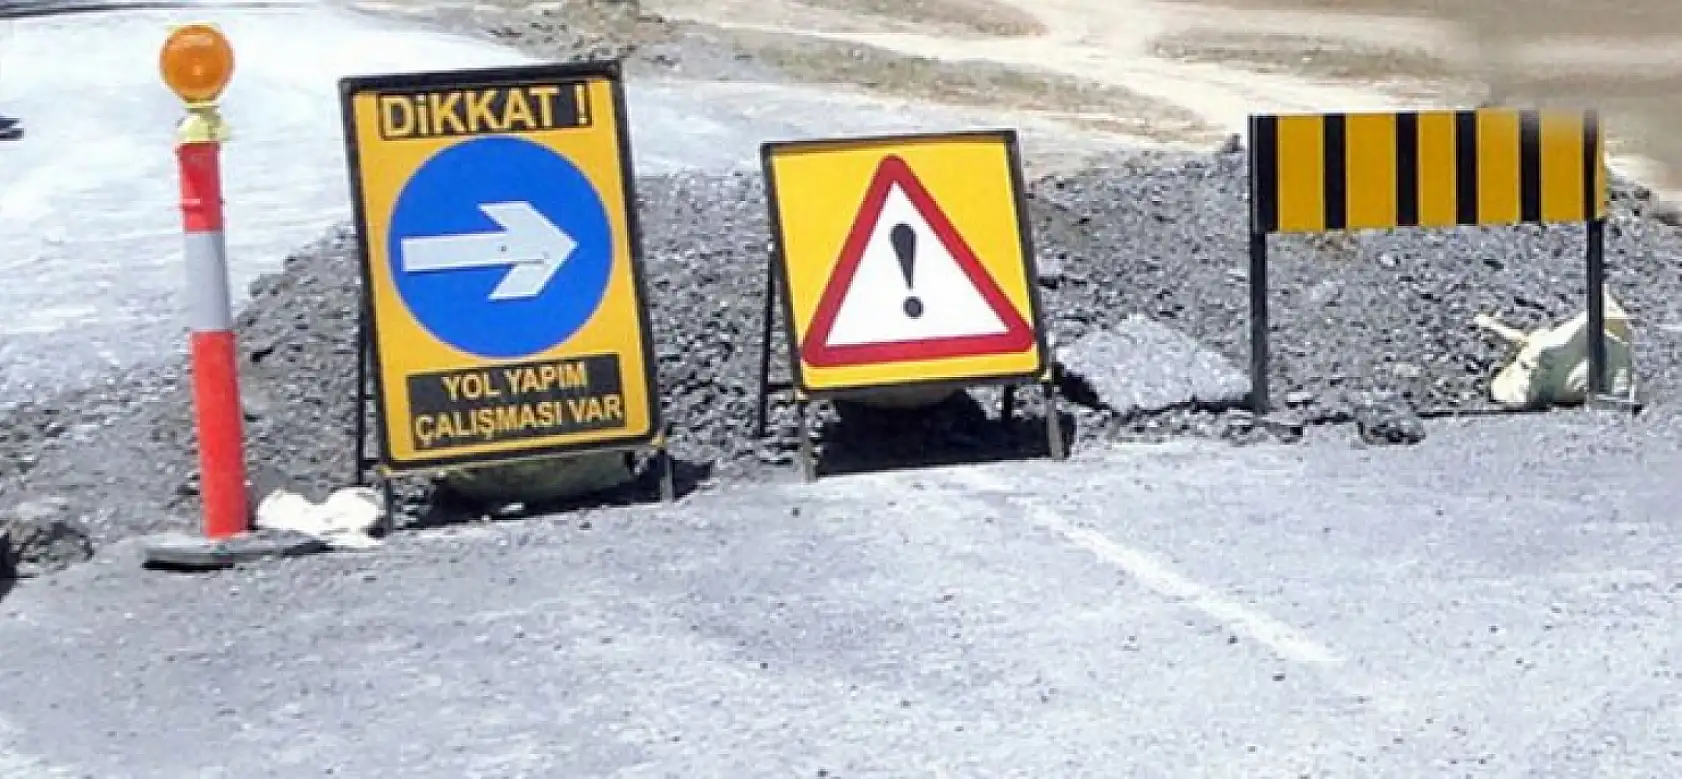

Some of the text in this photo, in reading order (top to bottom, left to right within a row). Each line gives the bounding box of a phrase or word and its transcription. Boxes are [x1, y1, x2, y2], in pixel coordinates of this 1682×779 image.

[441, 360, 588, 402] YOL YAPIM
[415, 393, 623, 445] ÇALIŞMASI VAR
